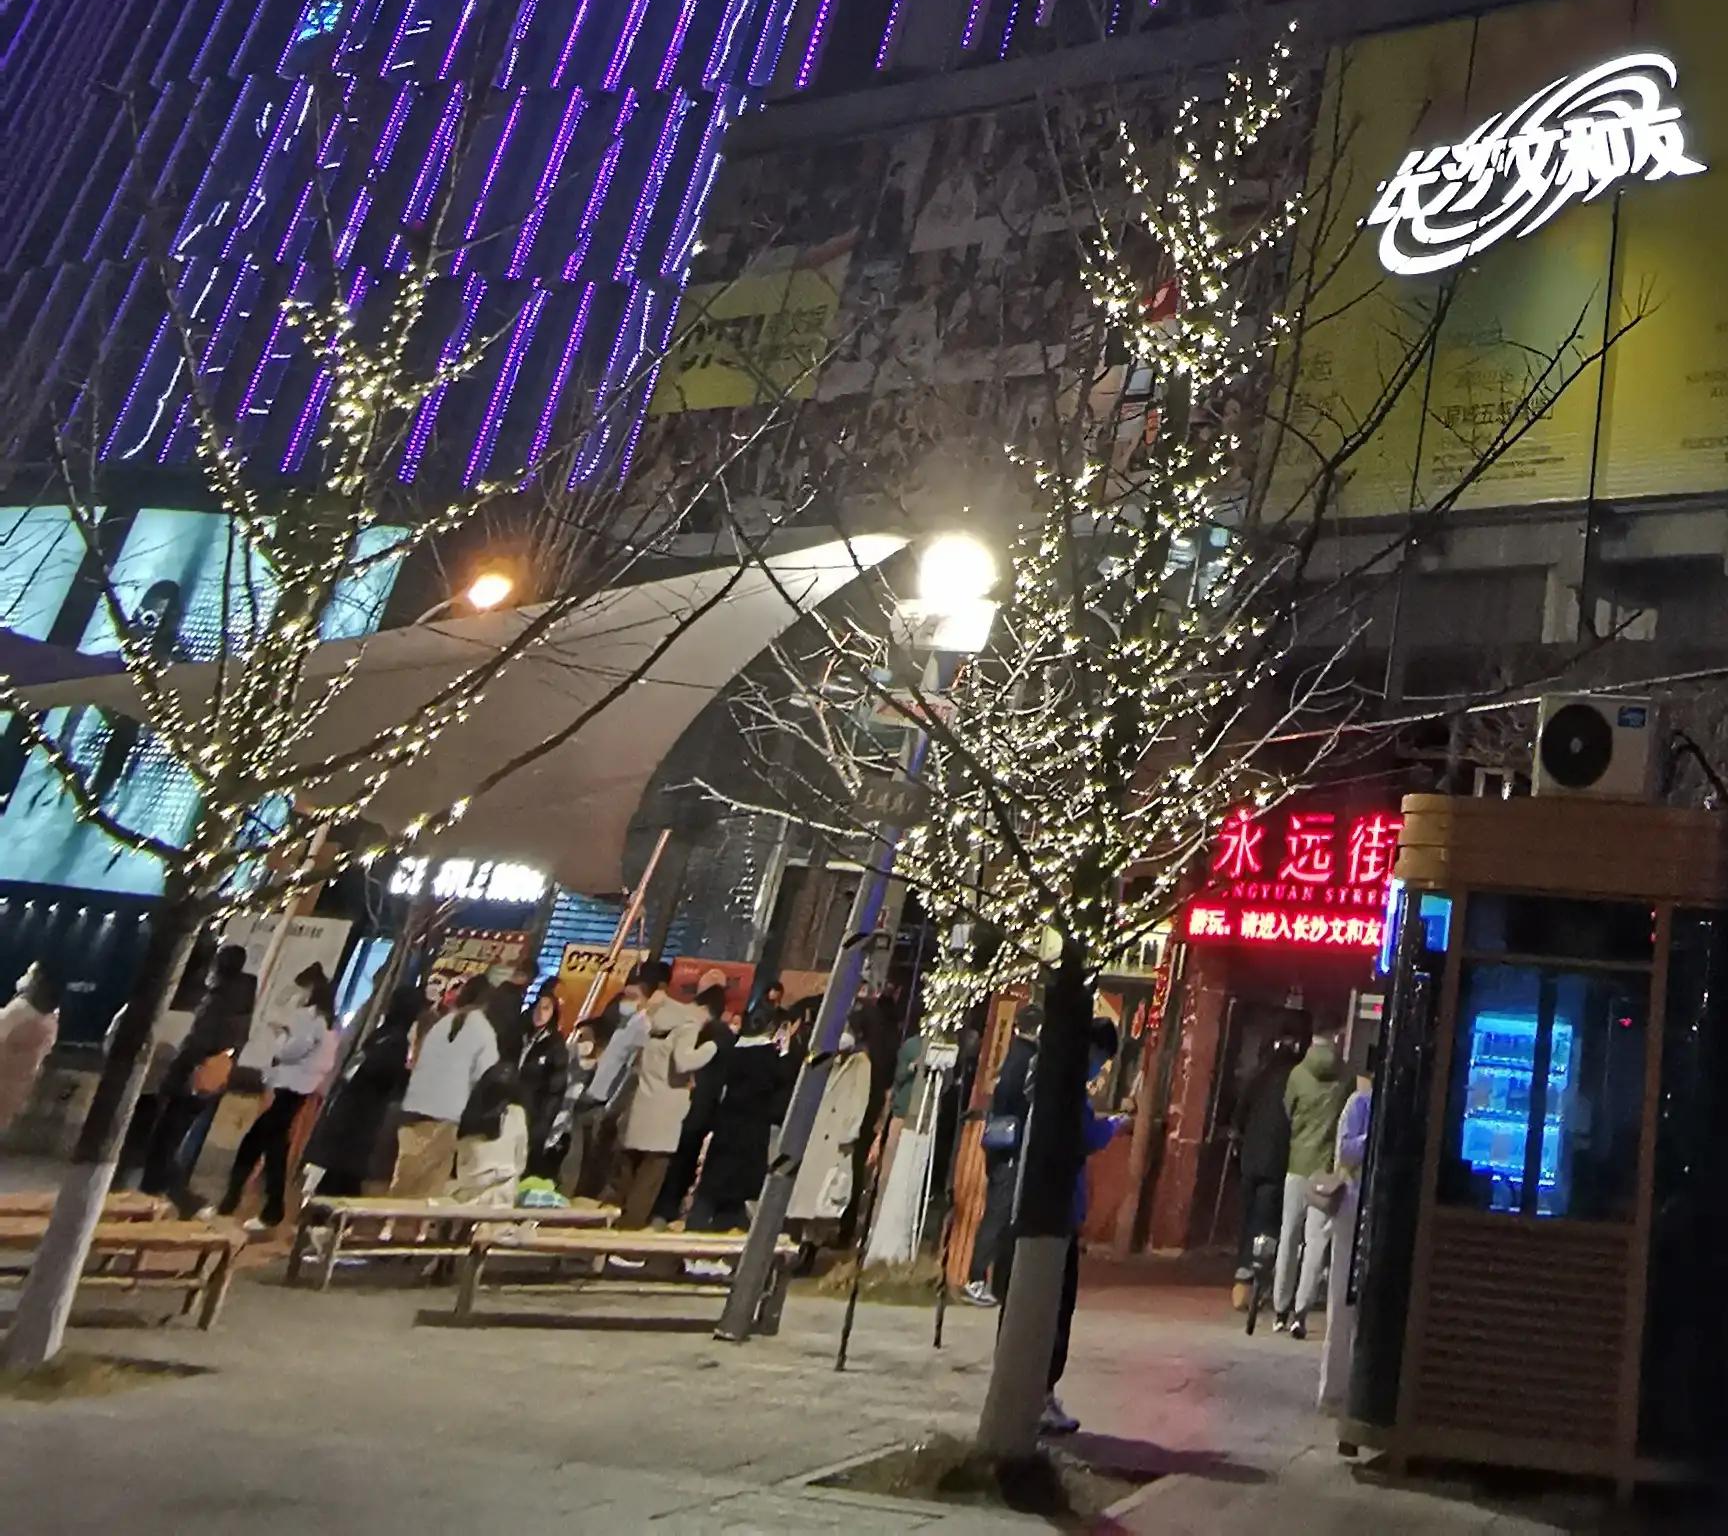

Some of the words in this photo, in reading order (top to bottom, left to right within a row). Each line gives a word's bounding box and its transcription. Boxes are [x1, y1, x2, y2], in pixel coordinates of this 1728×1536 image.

[1213, 812, 1403, 885] 永远街
[1222, 882, 1314, 901] NGYUAN
[1325, 887, 1390, 906] STREE
